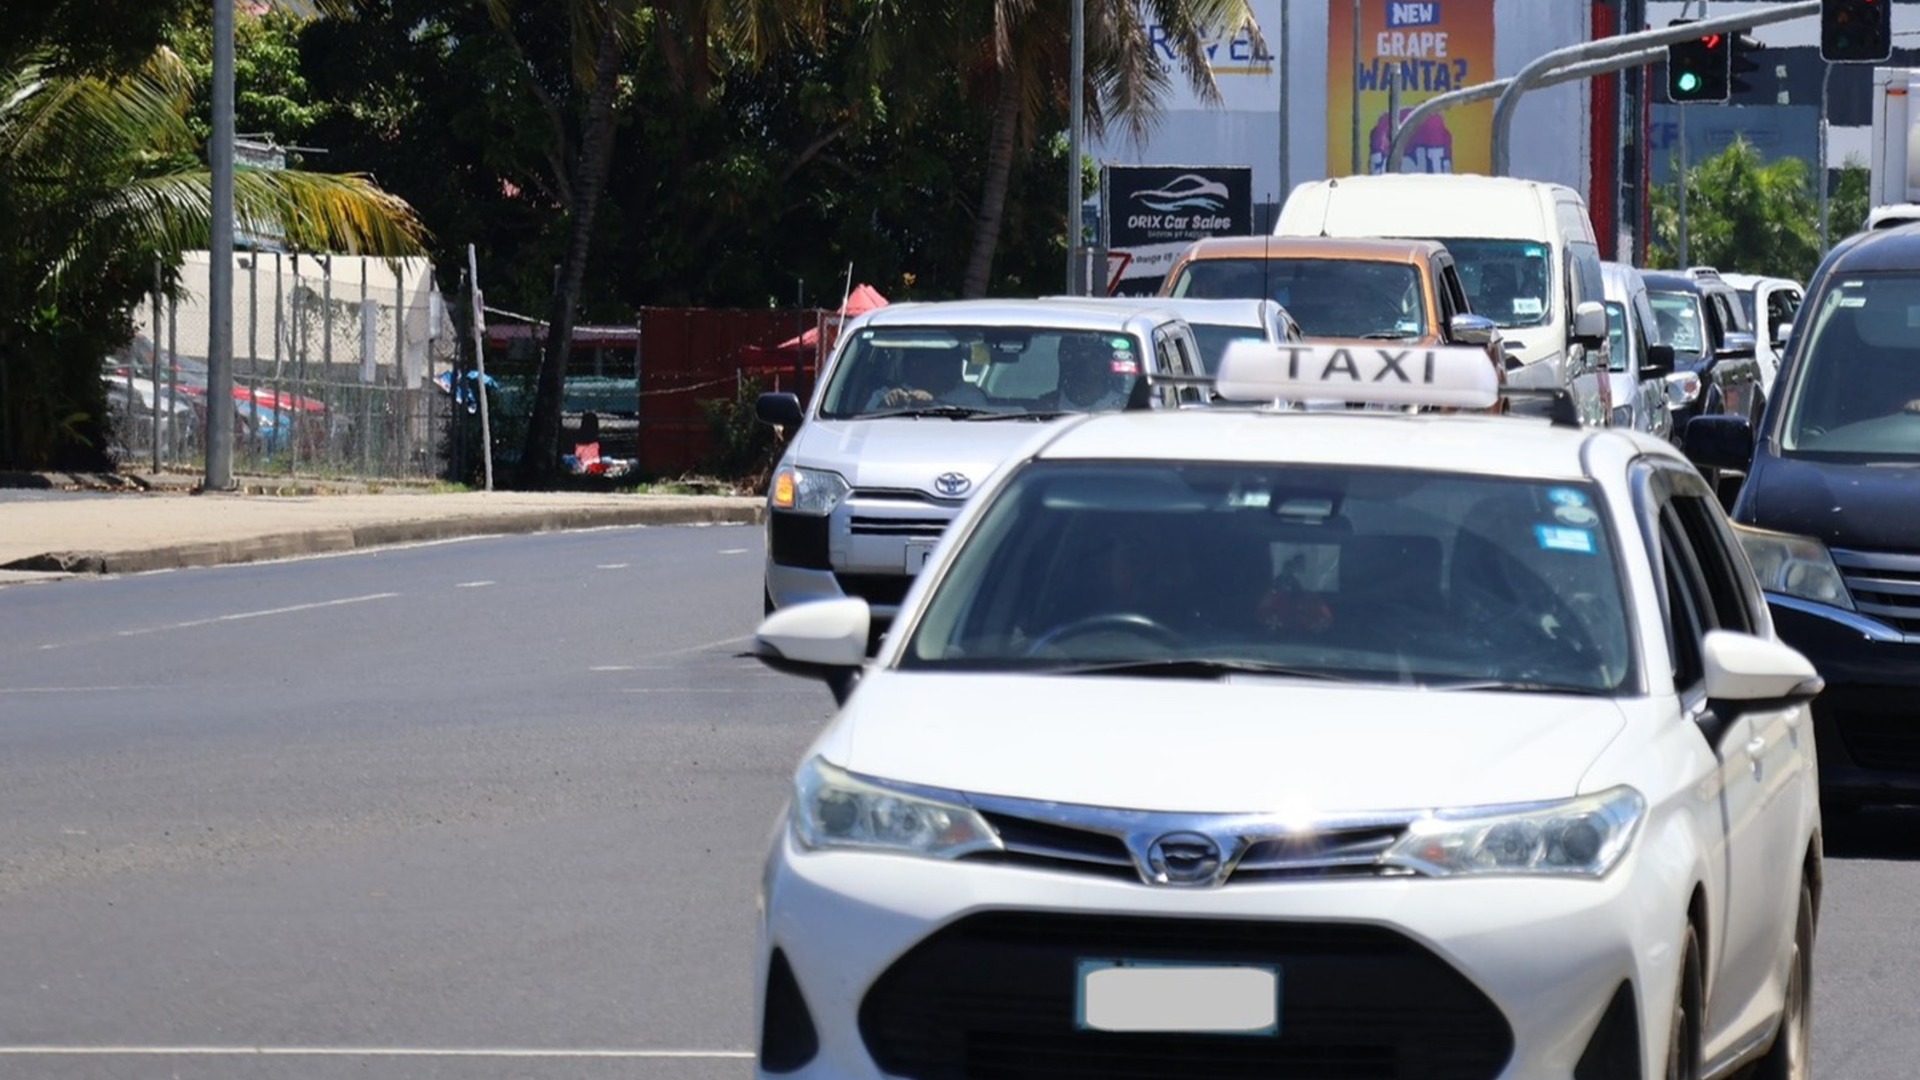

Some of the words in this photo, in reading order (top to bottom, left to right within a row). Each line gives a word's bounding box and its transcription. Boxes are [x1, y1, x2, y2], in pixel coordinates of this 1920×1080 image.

[1392, 3, 1433, 24] NEW
[1377, 31, 1448, 57] GRAPE
[1128, 215, 1162, 229] ORIX
[1164, 215, 1189, 229] Car
[1192, 214, 1231, 229] Sales
[1278, 346, 1435, 384] TAXI
